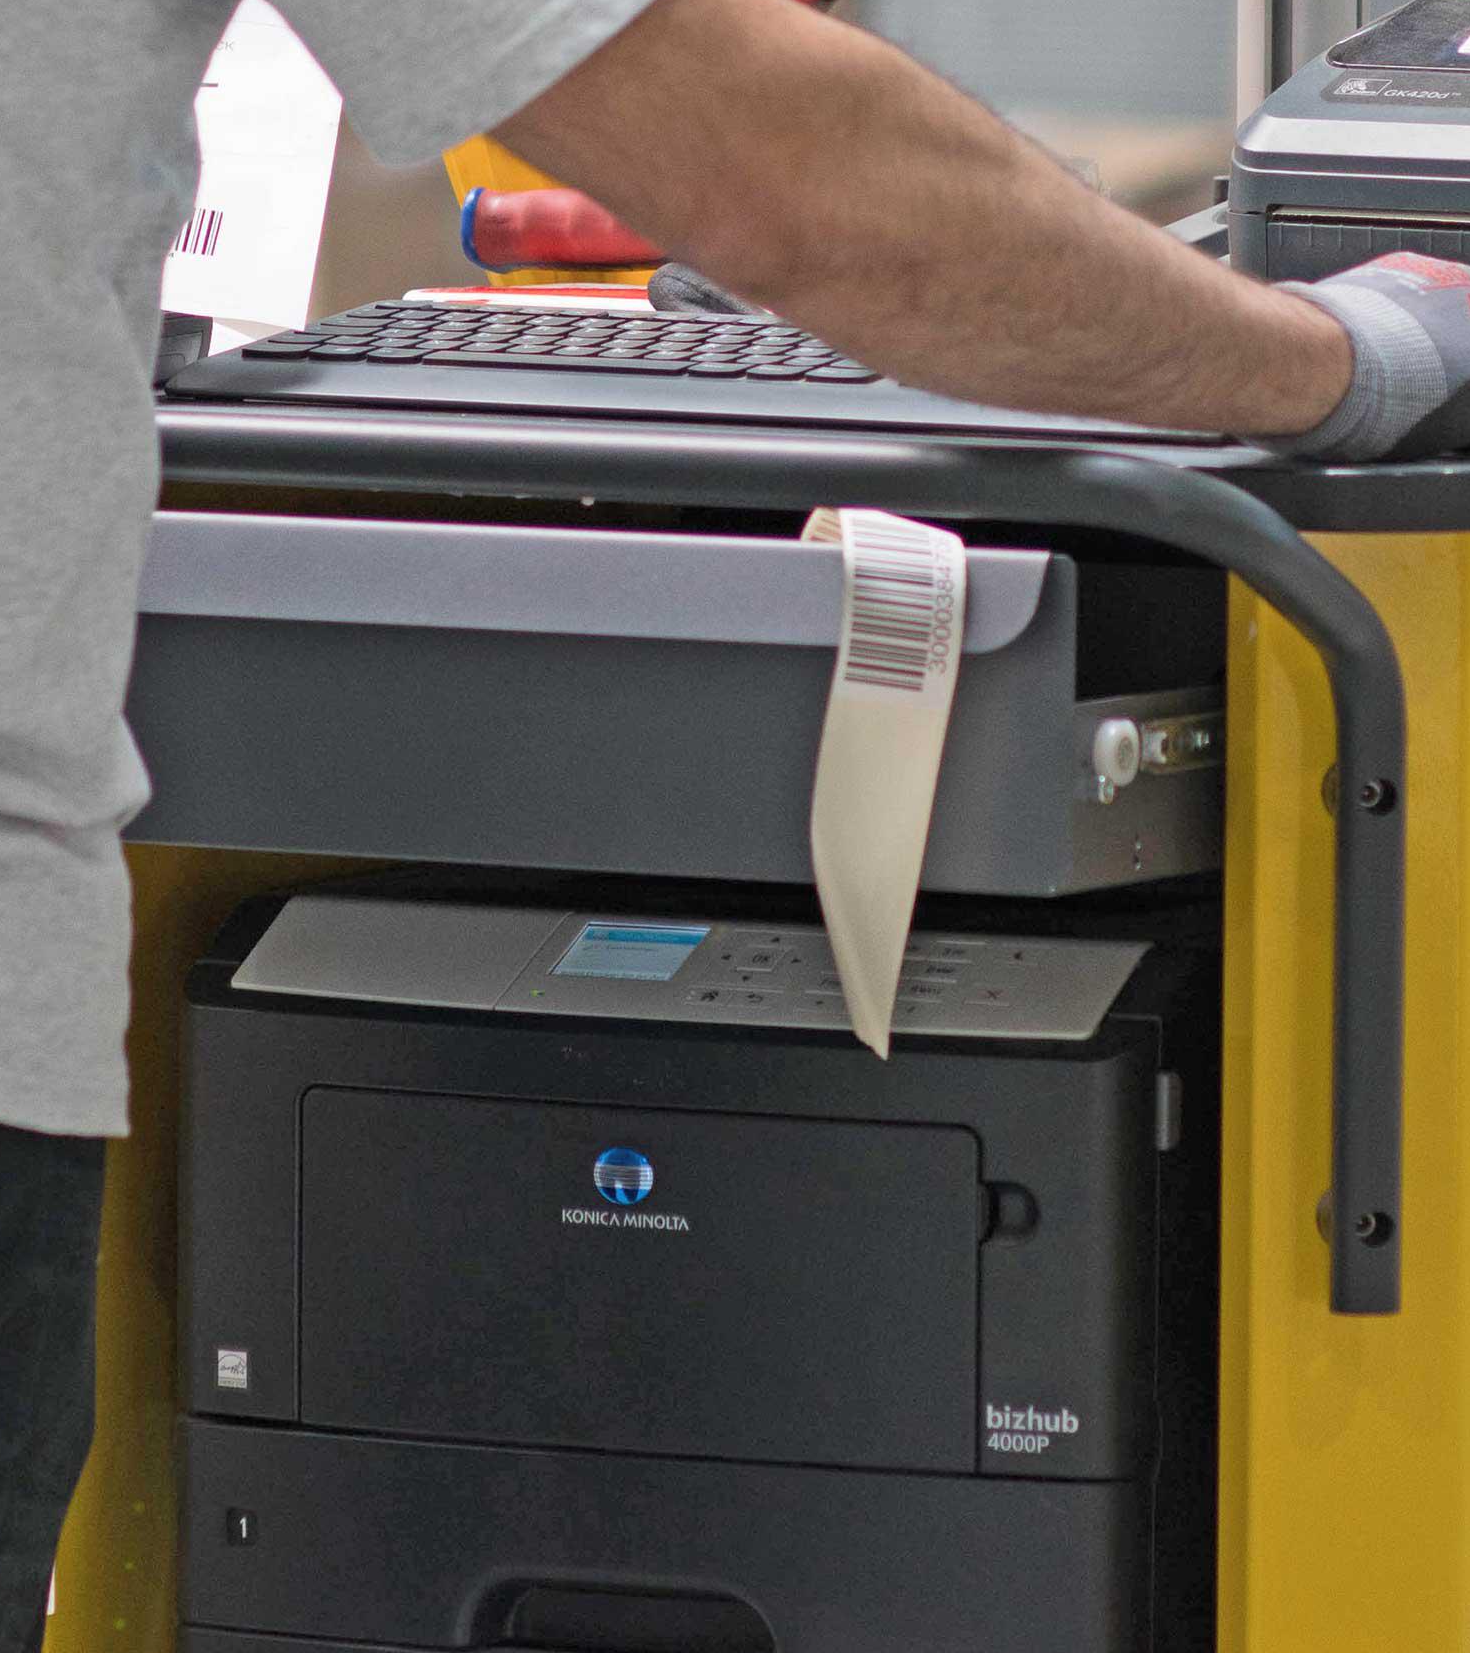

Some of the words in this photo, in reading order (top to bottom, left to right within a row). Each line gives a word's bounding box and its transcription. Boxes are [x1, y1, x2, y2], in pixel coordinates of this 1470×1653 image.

[561, 1209, 620, 1227] KONICA
[623, 1213, 689, 1231] MINOLTA
[986, 1405, 1079, 1433] bizhub
[988, 1433, 1049, 1453] 4000P
[239, 1517, 247, 1539] 1
